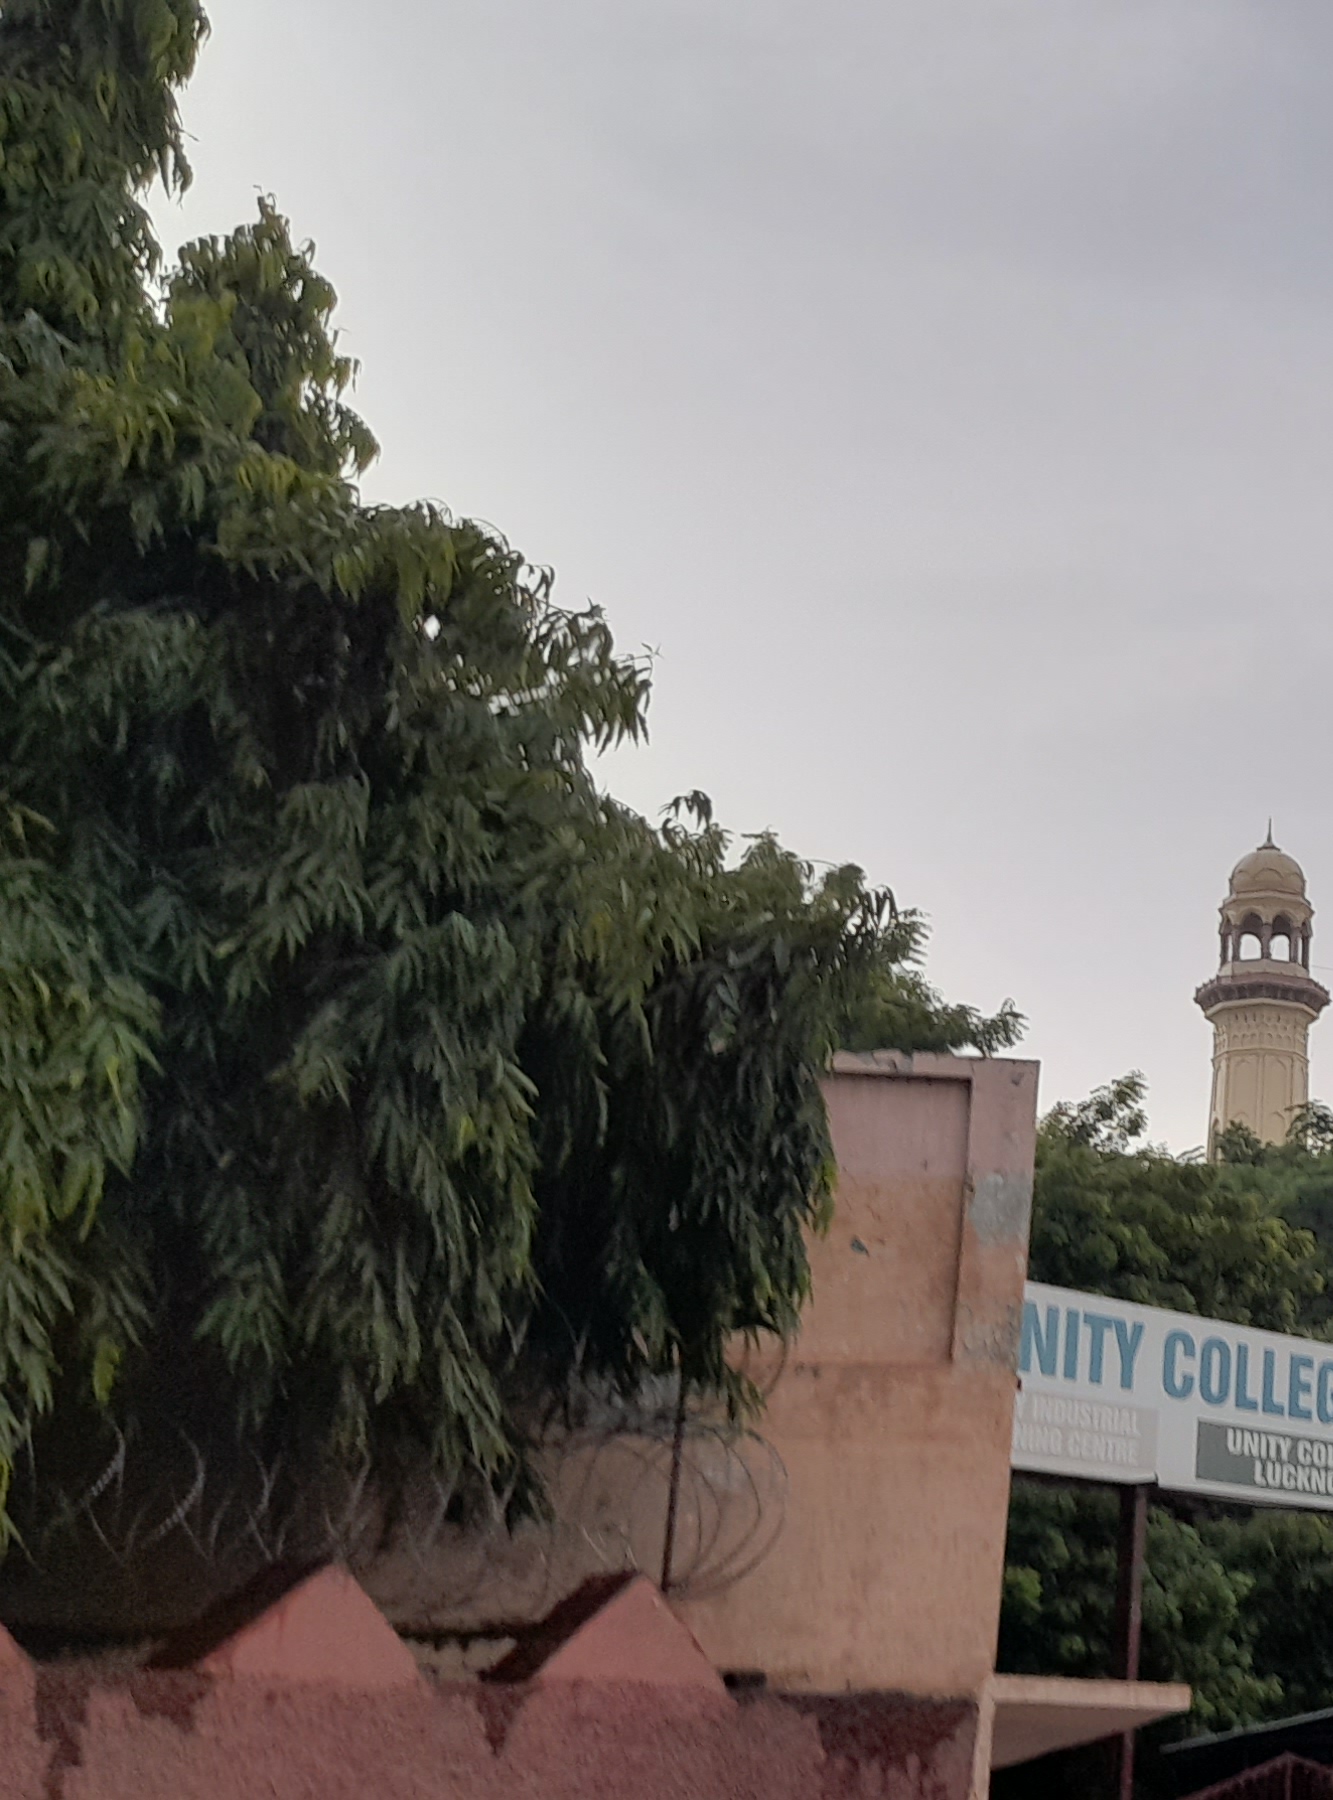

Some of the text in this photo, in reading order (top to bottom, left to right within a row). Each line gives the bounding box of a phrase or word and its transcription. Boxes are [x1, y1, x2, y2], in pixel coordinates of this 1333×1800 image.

[1032, 1394, 1141, 1436] INDUSTRIAL
[1067, 1429, 1140, 1466] CENTRE
[1227, 1428, 1292, 1462] UNITY
